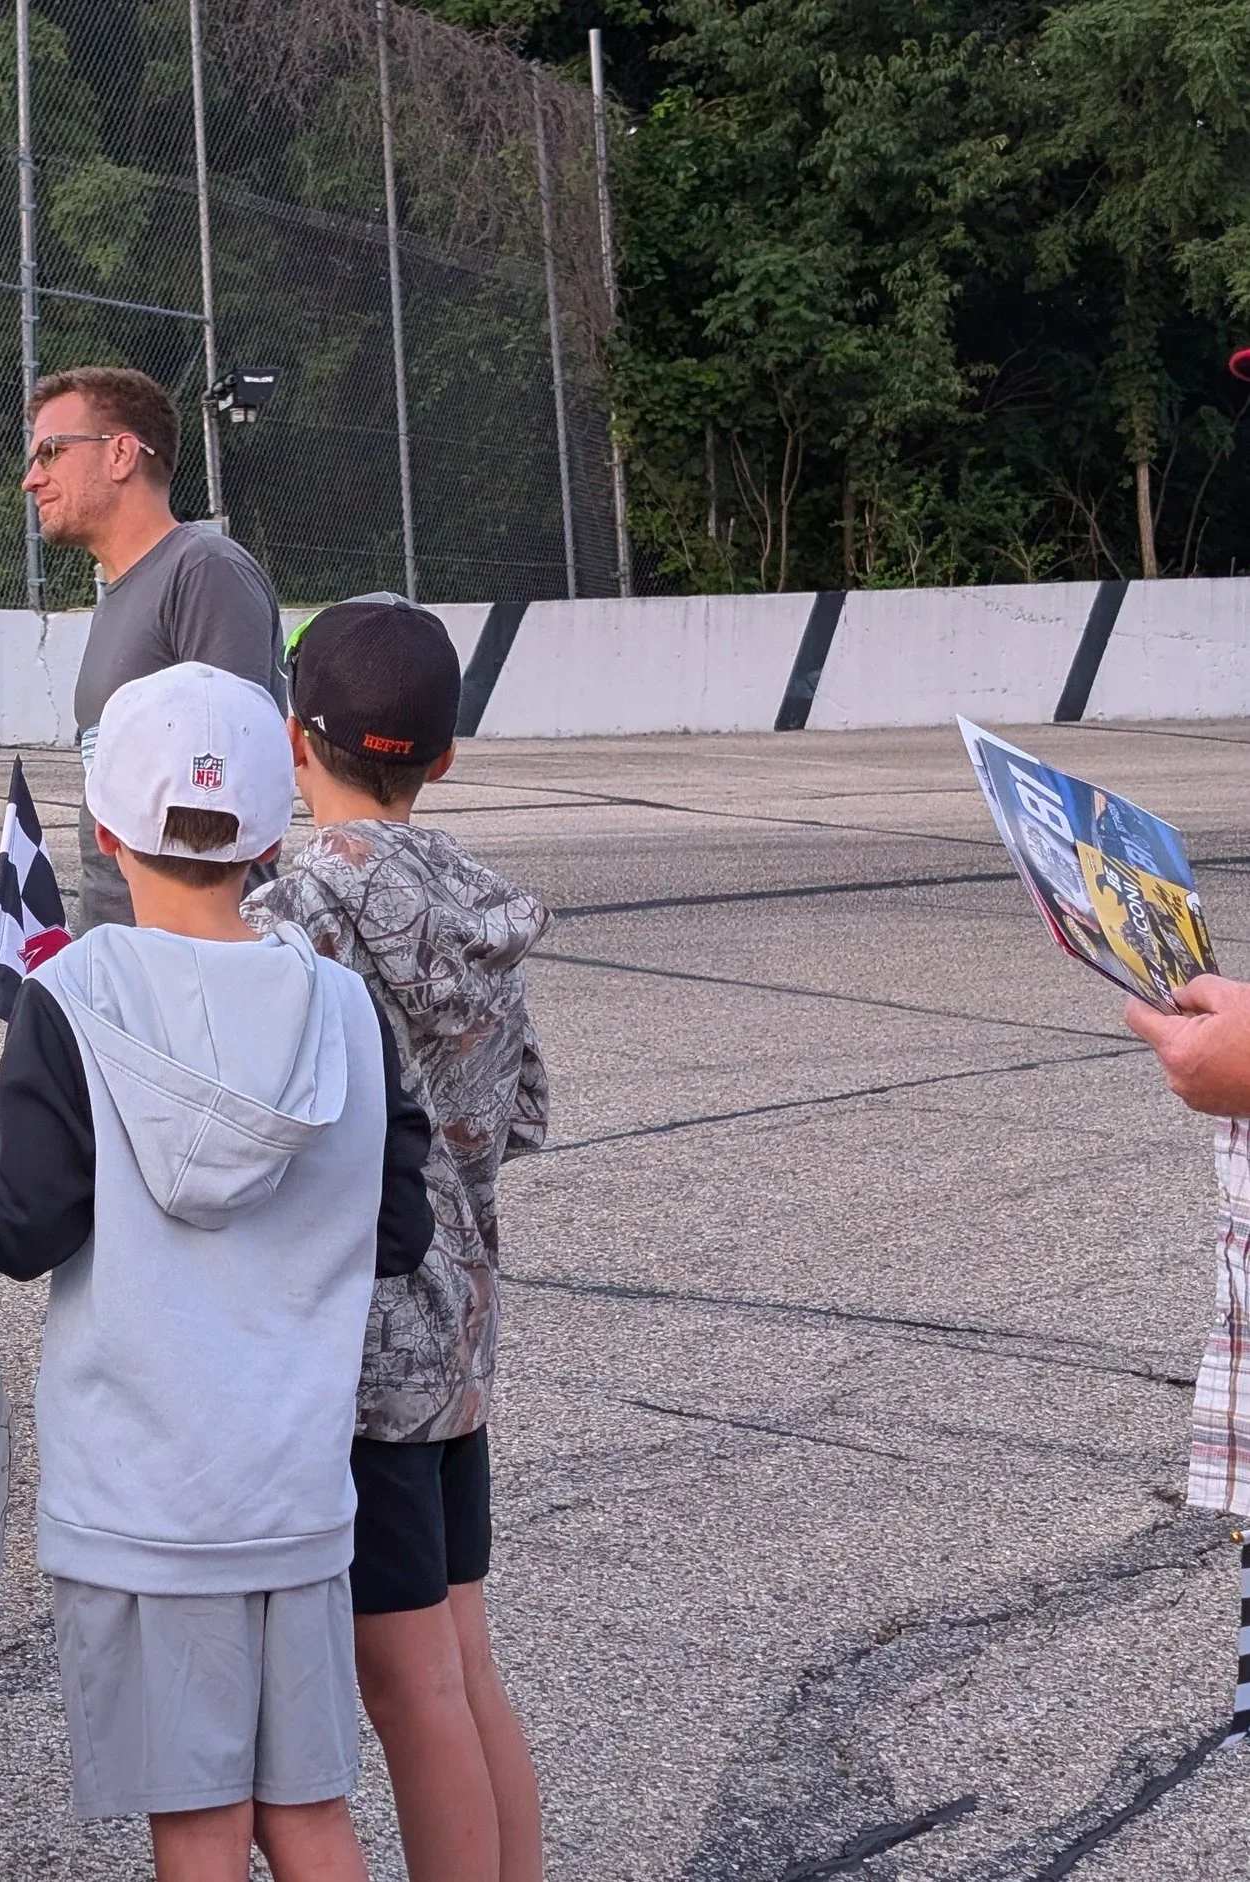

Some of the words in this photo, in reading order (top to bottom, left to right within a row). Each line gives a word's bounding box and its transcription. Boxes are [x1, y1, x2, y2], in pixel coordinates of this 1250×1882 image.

[362, 733, 414, 755] HEFTY
[196, 770, 222, 787] NFL
[1007, 760, 1076, 844] 81
